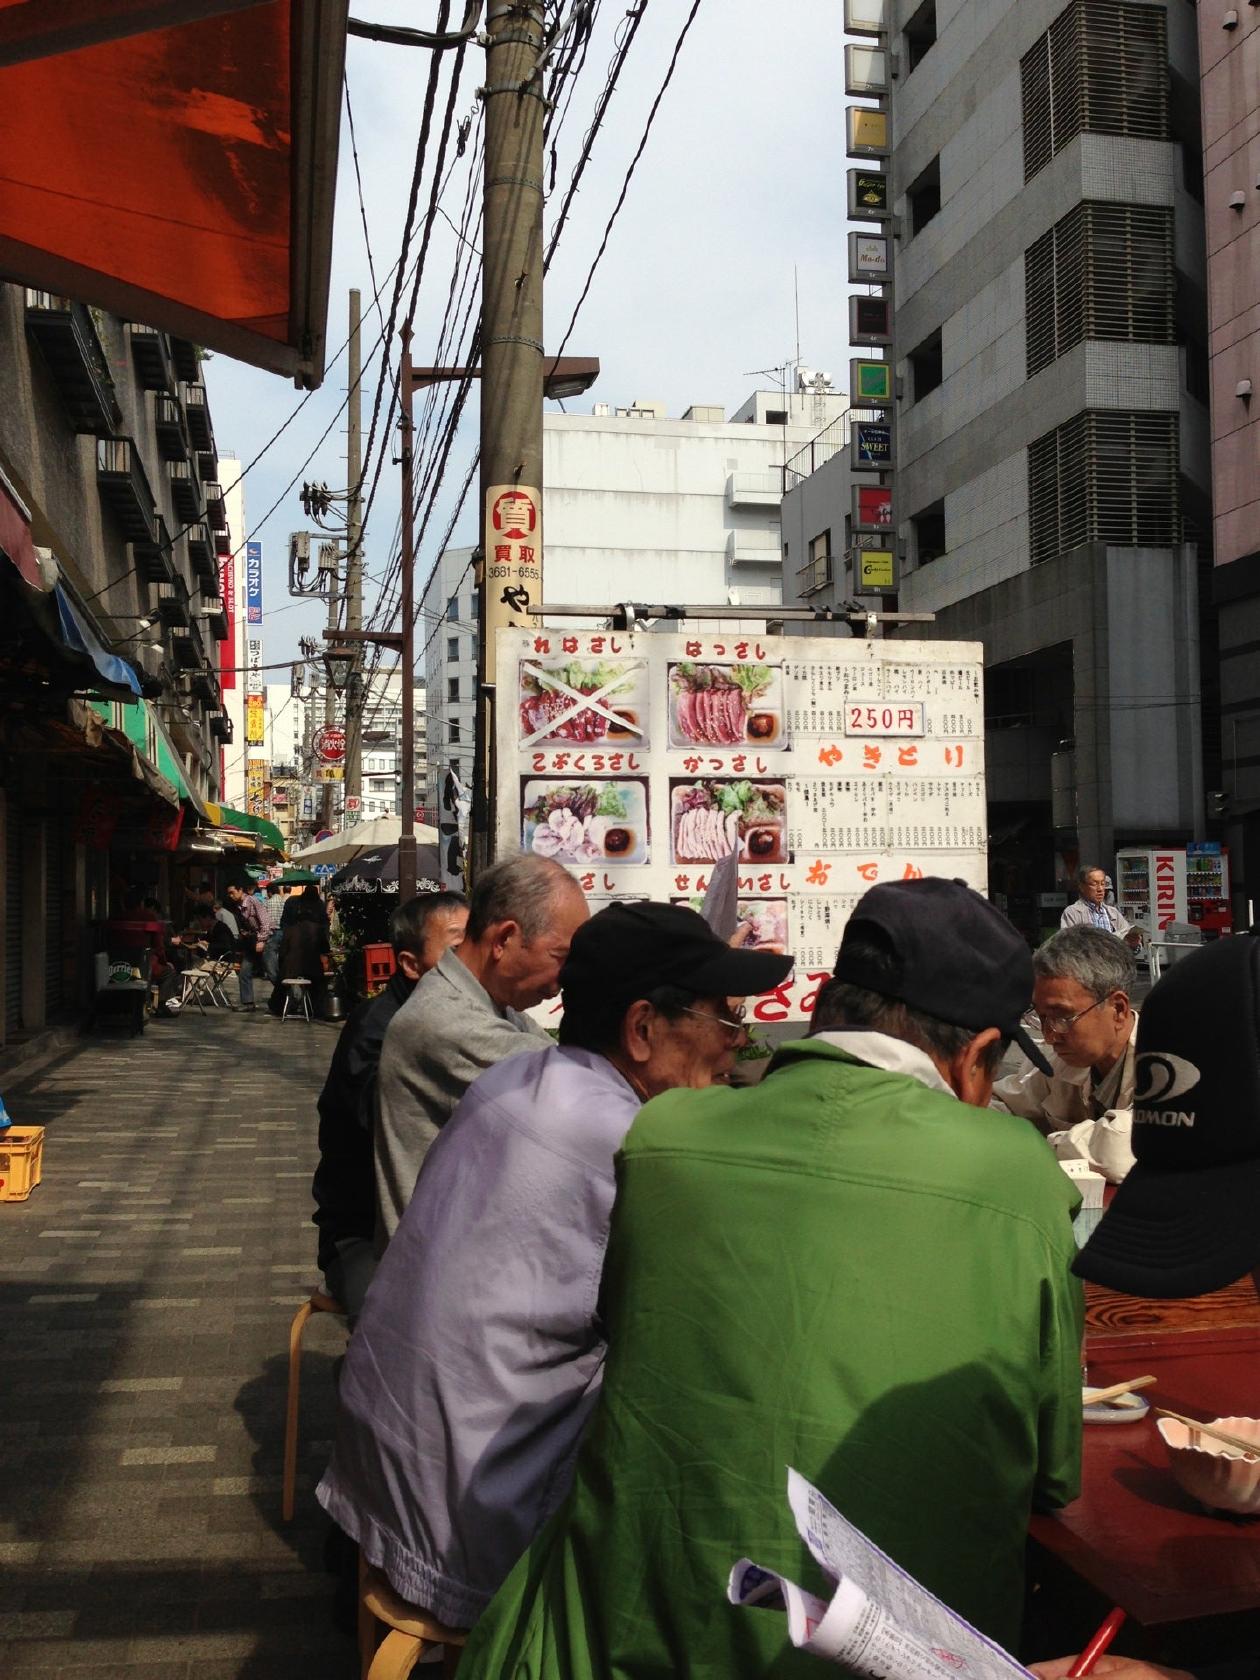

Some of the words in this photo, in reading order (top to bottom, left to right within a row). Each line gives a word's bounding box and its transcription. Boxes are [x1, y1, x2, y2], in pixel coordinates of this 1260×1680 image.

[860, 442, 888, 452] SWEET
[494, 544, 535, 564] 買取
[248, 558, 260, 597] カラオケ
[488, 566, 540, 580] 3681-6555
[851, 708, 914, 731] 250円
[321, 738, 346, 751] 消火栓
[818, 744, 964, 769] やきとり
[1155, 856, 1177, 931] KIRIN
[1133, 1109, 1196, 1128] OMON
